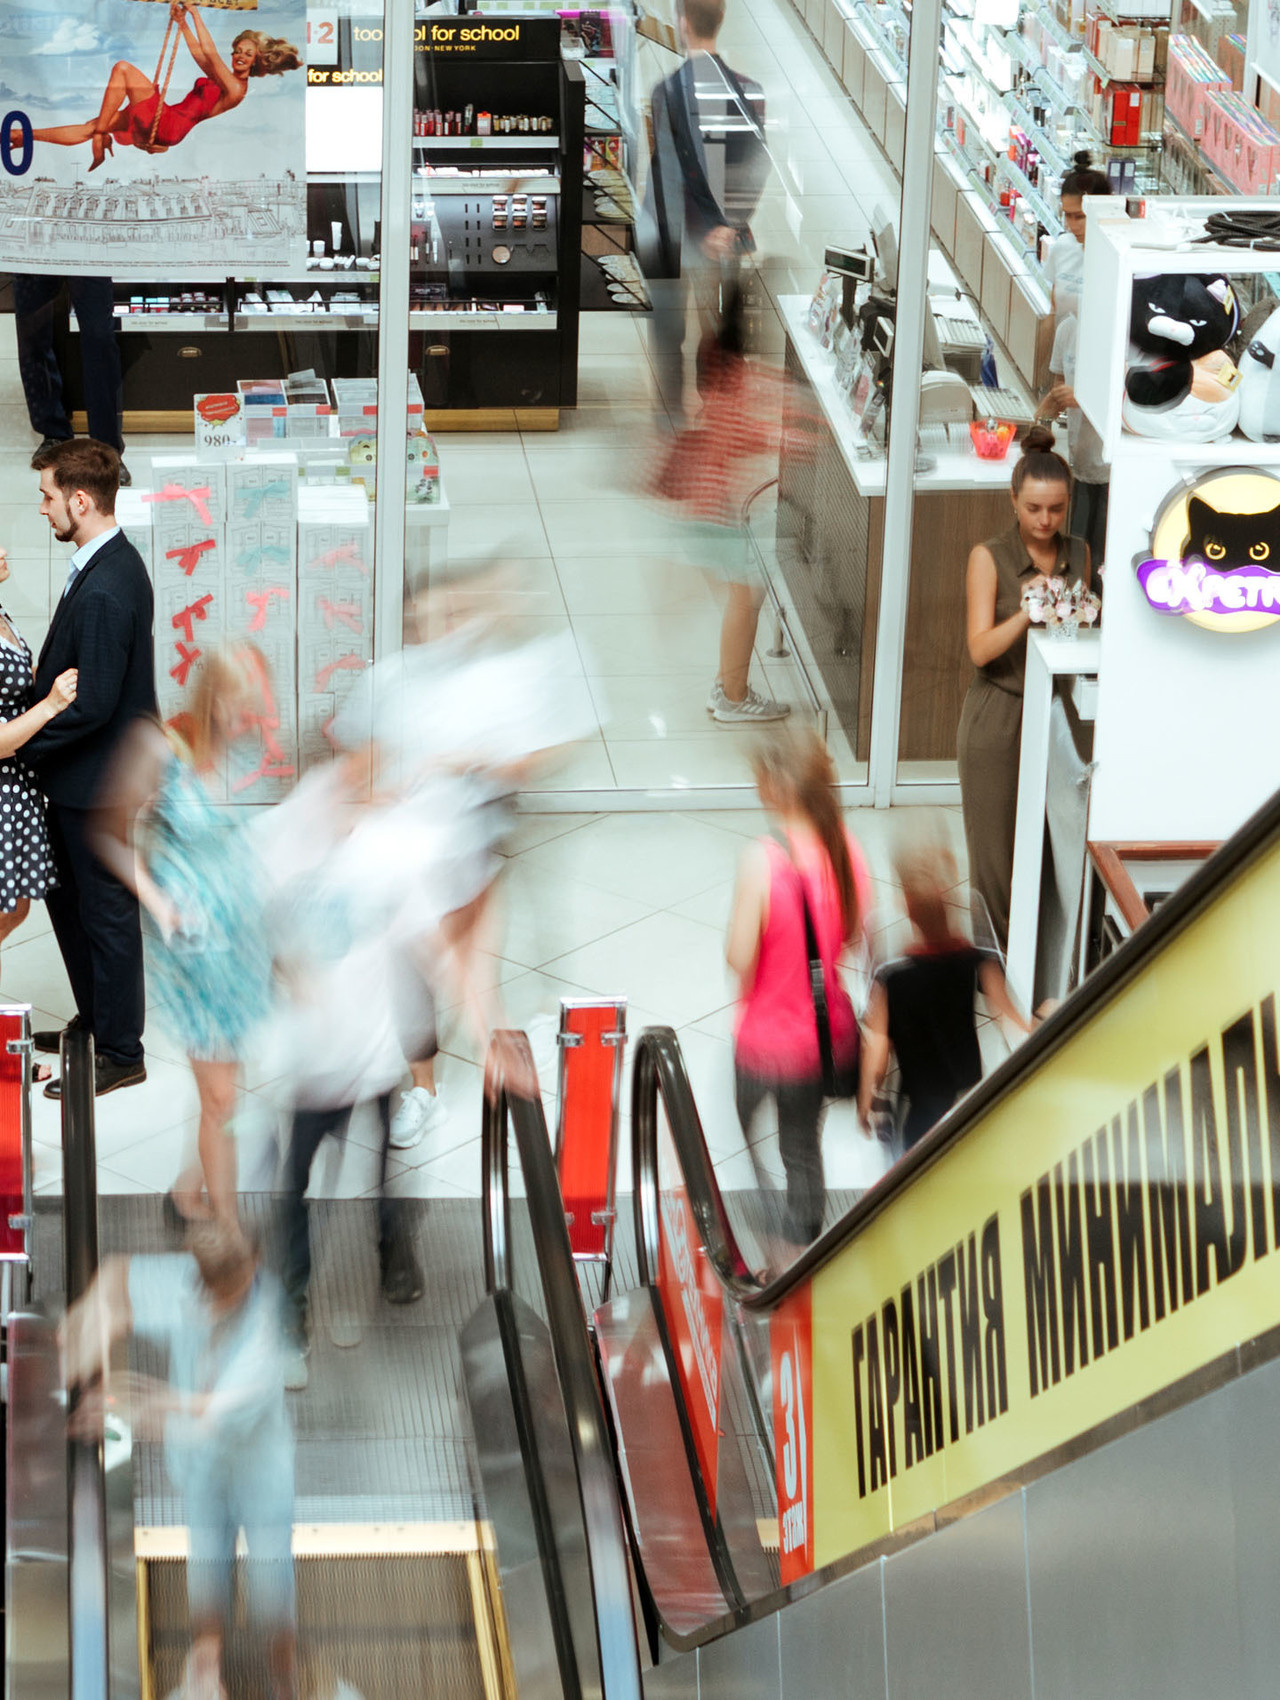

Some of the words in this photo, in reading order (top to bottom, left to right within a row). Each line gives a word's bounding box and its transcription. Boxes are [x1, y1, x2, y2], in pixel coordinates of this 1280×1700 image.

[353, 26, 383, 41] too
[431, 24, 457, 41] for
[460, 24, 520, 41] school
[308, 68, 329, 82] for
[332, 68, 383, 83] school
[851, 1211, 1009, 1499] ГАРАНТИЯ
[780, 1351, 797, 1500] 3
